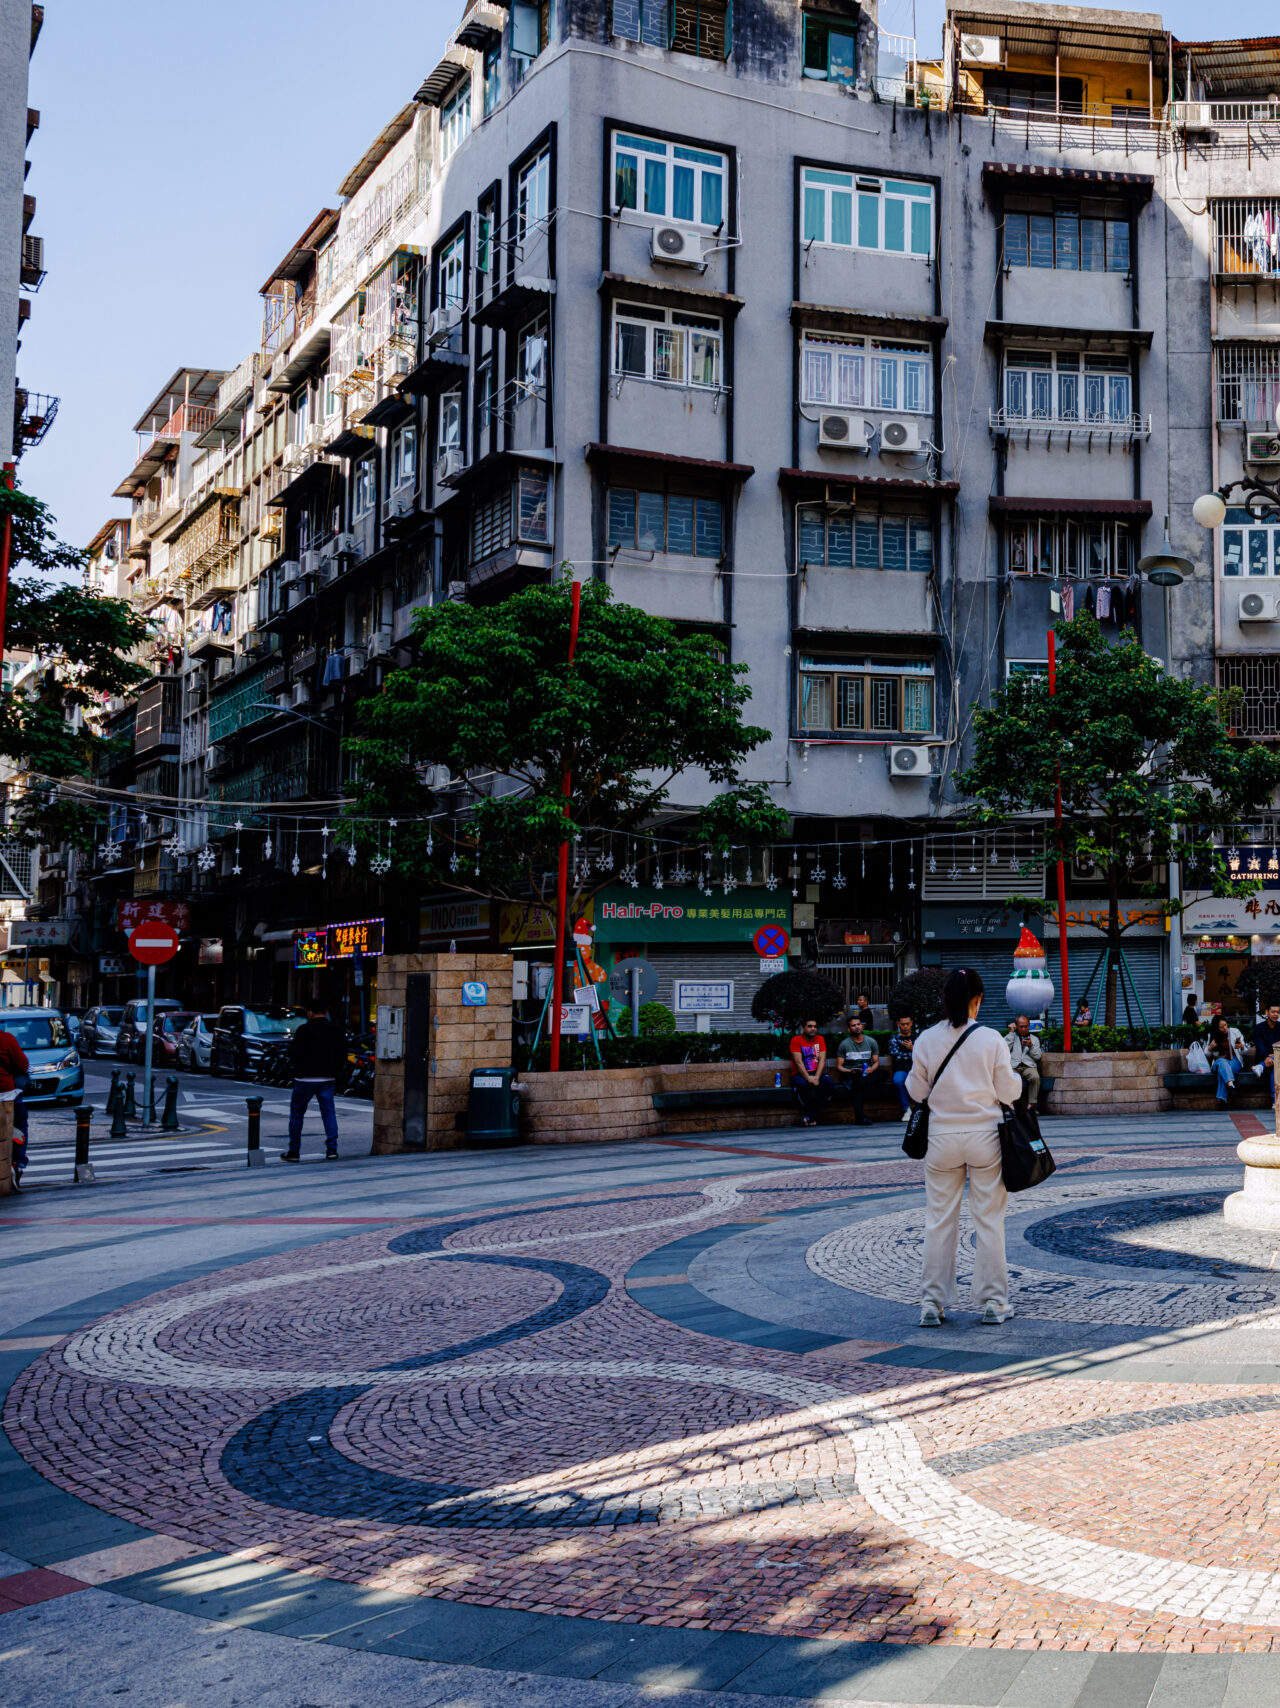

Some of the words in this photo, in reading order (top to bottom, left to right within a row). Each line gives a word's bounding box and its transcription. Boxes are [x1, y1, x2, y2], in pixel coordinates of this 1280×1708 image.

[1230, 872, 1279, 880] GATHERING
[602, 902, 684, 919] Hair-Pro
[686, 908, 787, 919] 專業美髮用品專門店
[431, 906, 457, 930] INDO
[956, 917, 978, 925] Talent
[981, 917, 1001, 925] Tme
